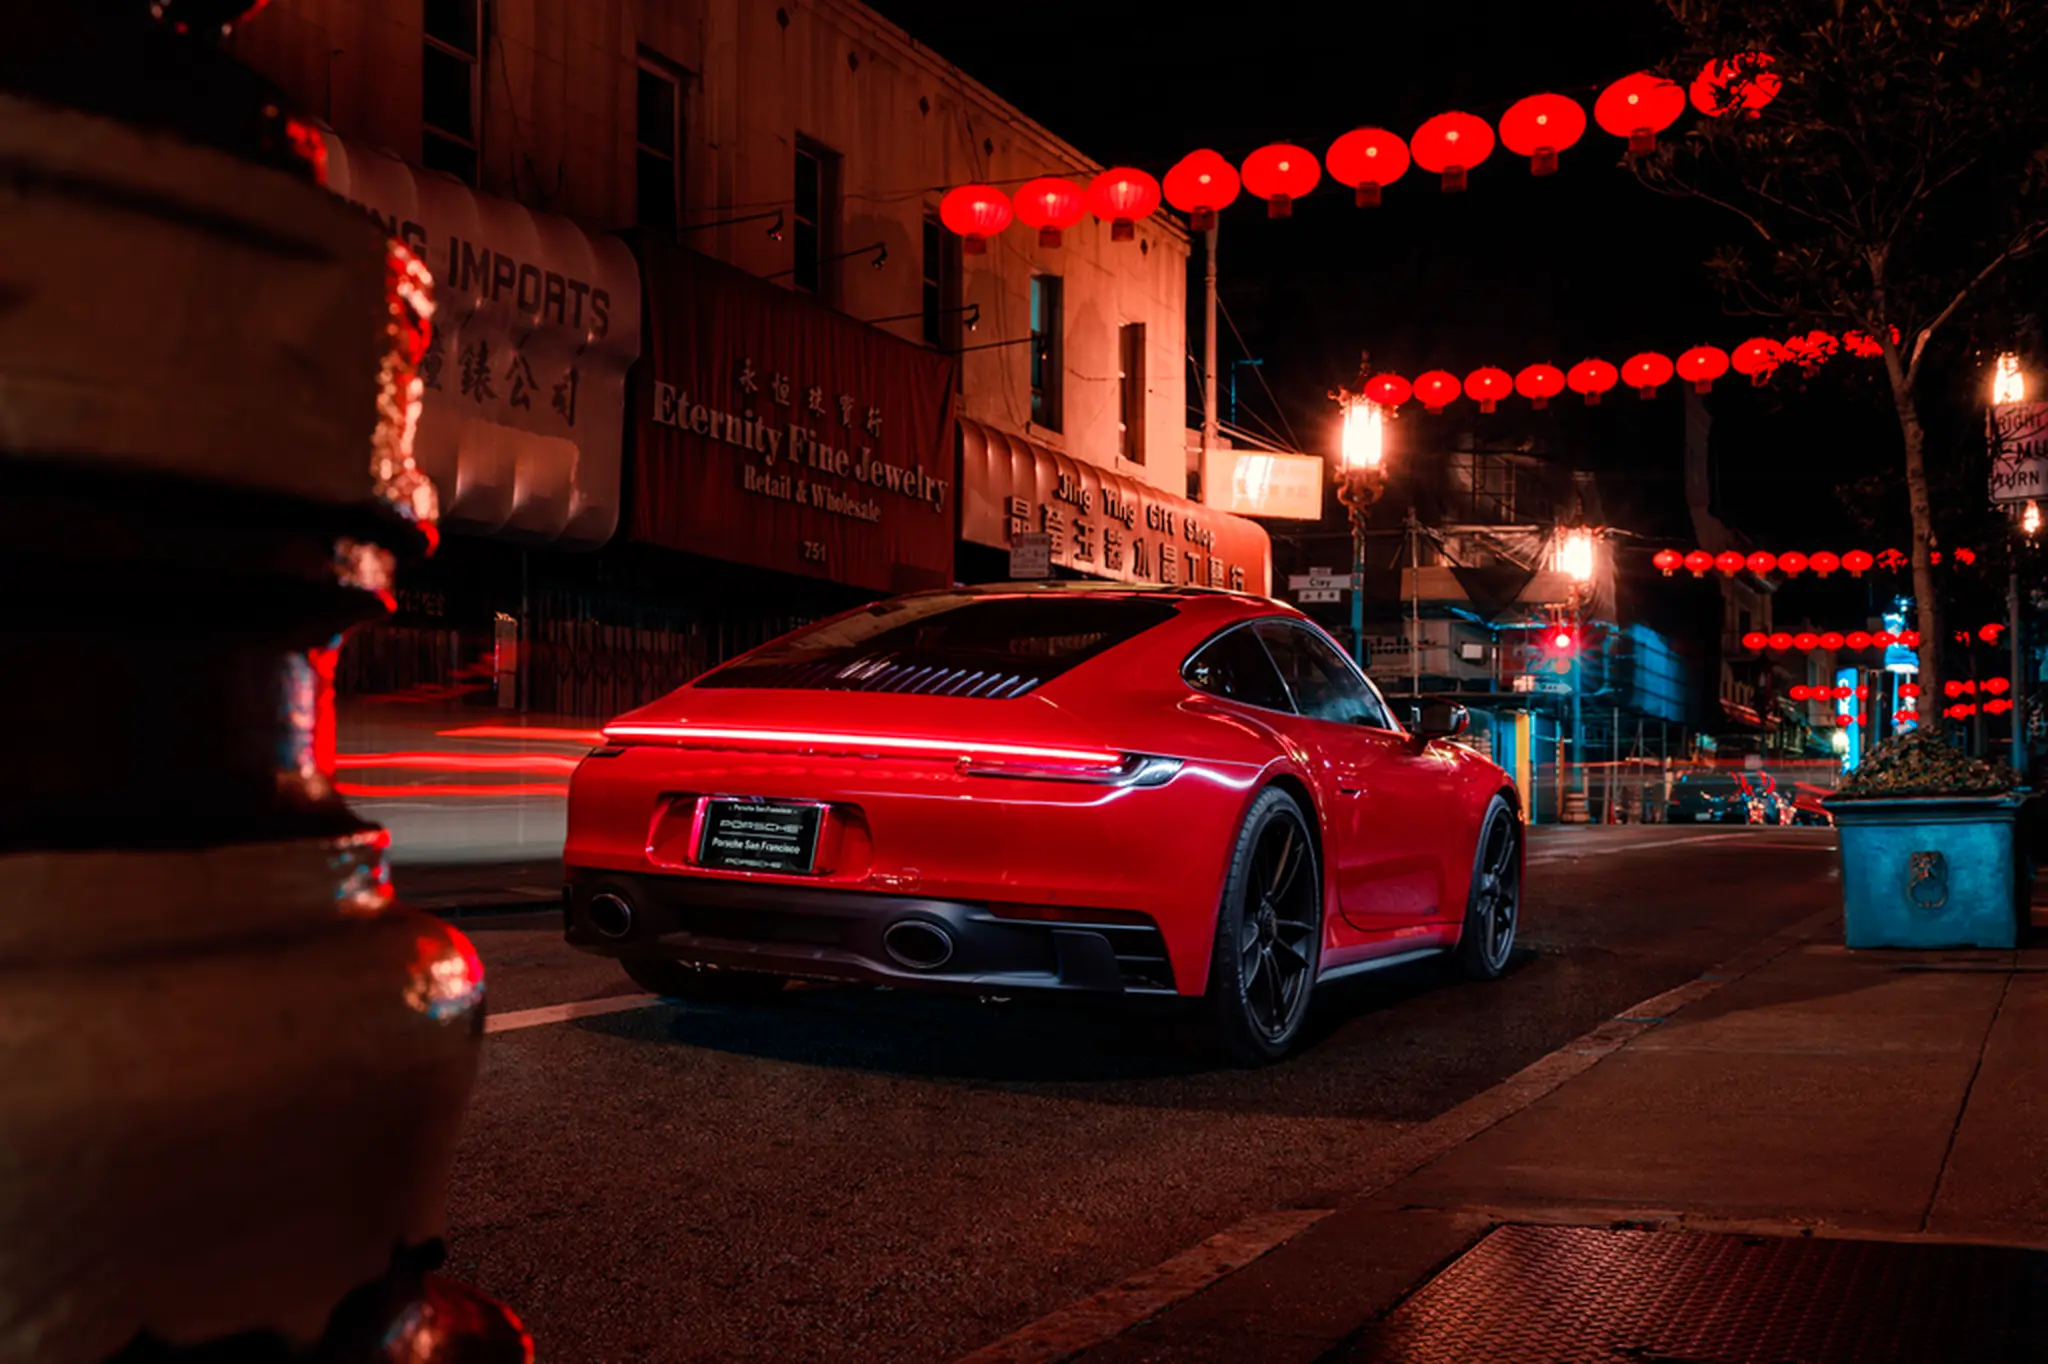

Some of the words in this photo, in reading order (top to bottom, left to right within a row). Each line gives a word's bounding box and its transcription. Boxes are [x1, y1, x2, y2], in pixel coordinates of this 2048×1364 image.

[448, 237, 611, 340] IMPORTS
[652, 379, 784, 466] Eternity
[787, 422, 850, 478] Fine
[854, 446, 950, 513] Jewelry
[743, 463, 792, 500] Retail
[795, 478, 808, 504] &
[811, 482, 882, 523] Wholesale
[1056, 472, 1094, 516] Jing
[1101, 487, 1136, 530] Ying
[1146, 500, 1175, 536] Gift
[1183, 517, 1217, 553] Shop
[803, 540, 827, 562] 751
[711, 836, 743, 850] Porsche
[744, 839, 761, 851] San
[761, 840, 801, 855] Francisco
[720, 819, 800, 834] PORSCHE
